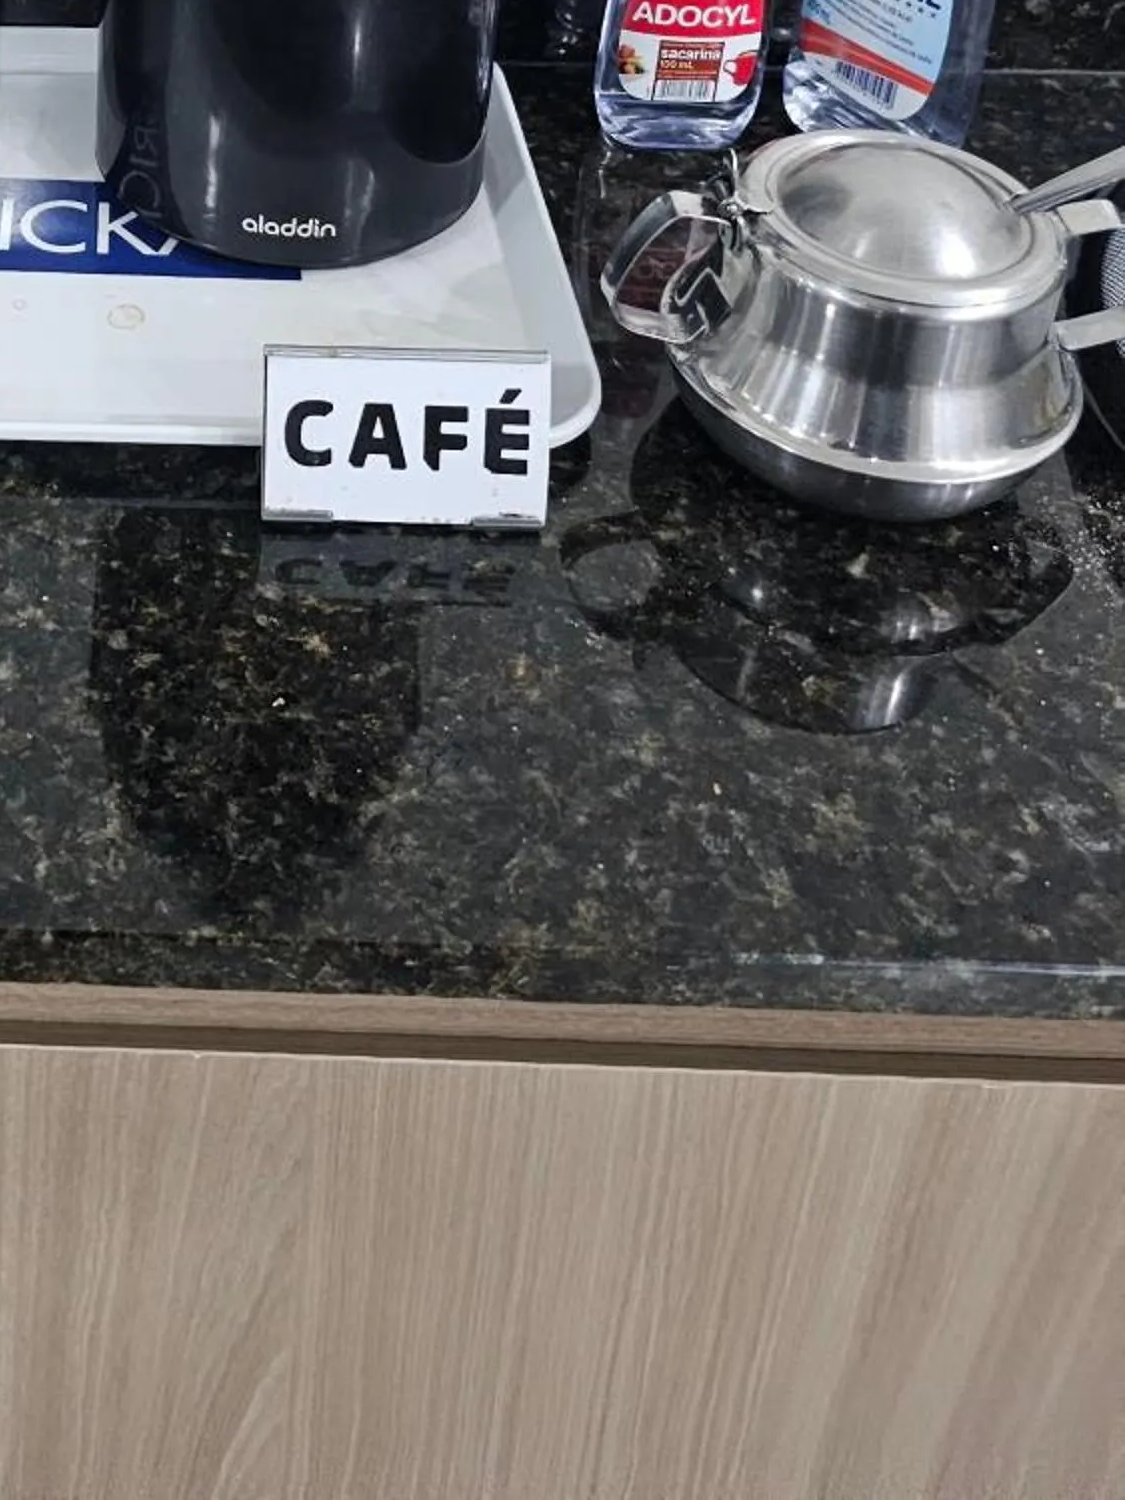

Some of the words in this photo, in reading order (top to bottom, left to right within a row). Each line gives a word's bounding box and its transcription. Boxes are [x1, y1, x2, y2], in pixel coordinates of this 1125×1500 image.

[632, 1, 756, 28] ADOCYL
[660, 48, 722, 61] sacarina
[242, 215, 336, 239] aladdin
[284, 388, 531, 476] CAFÉ
